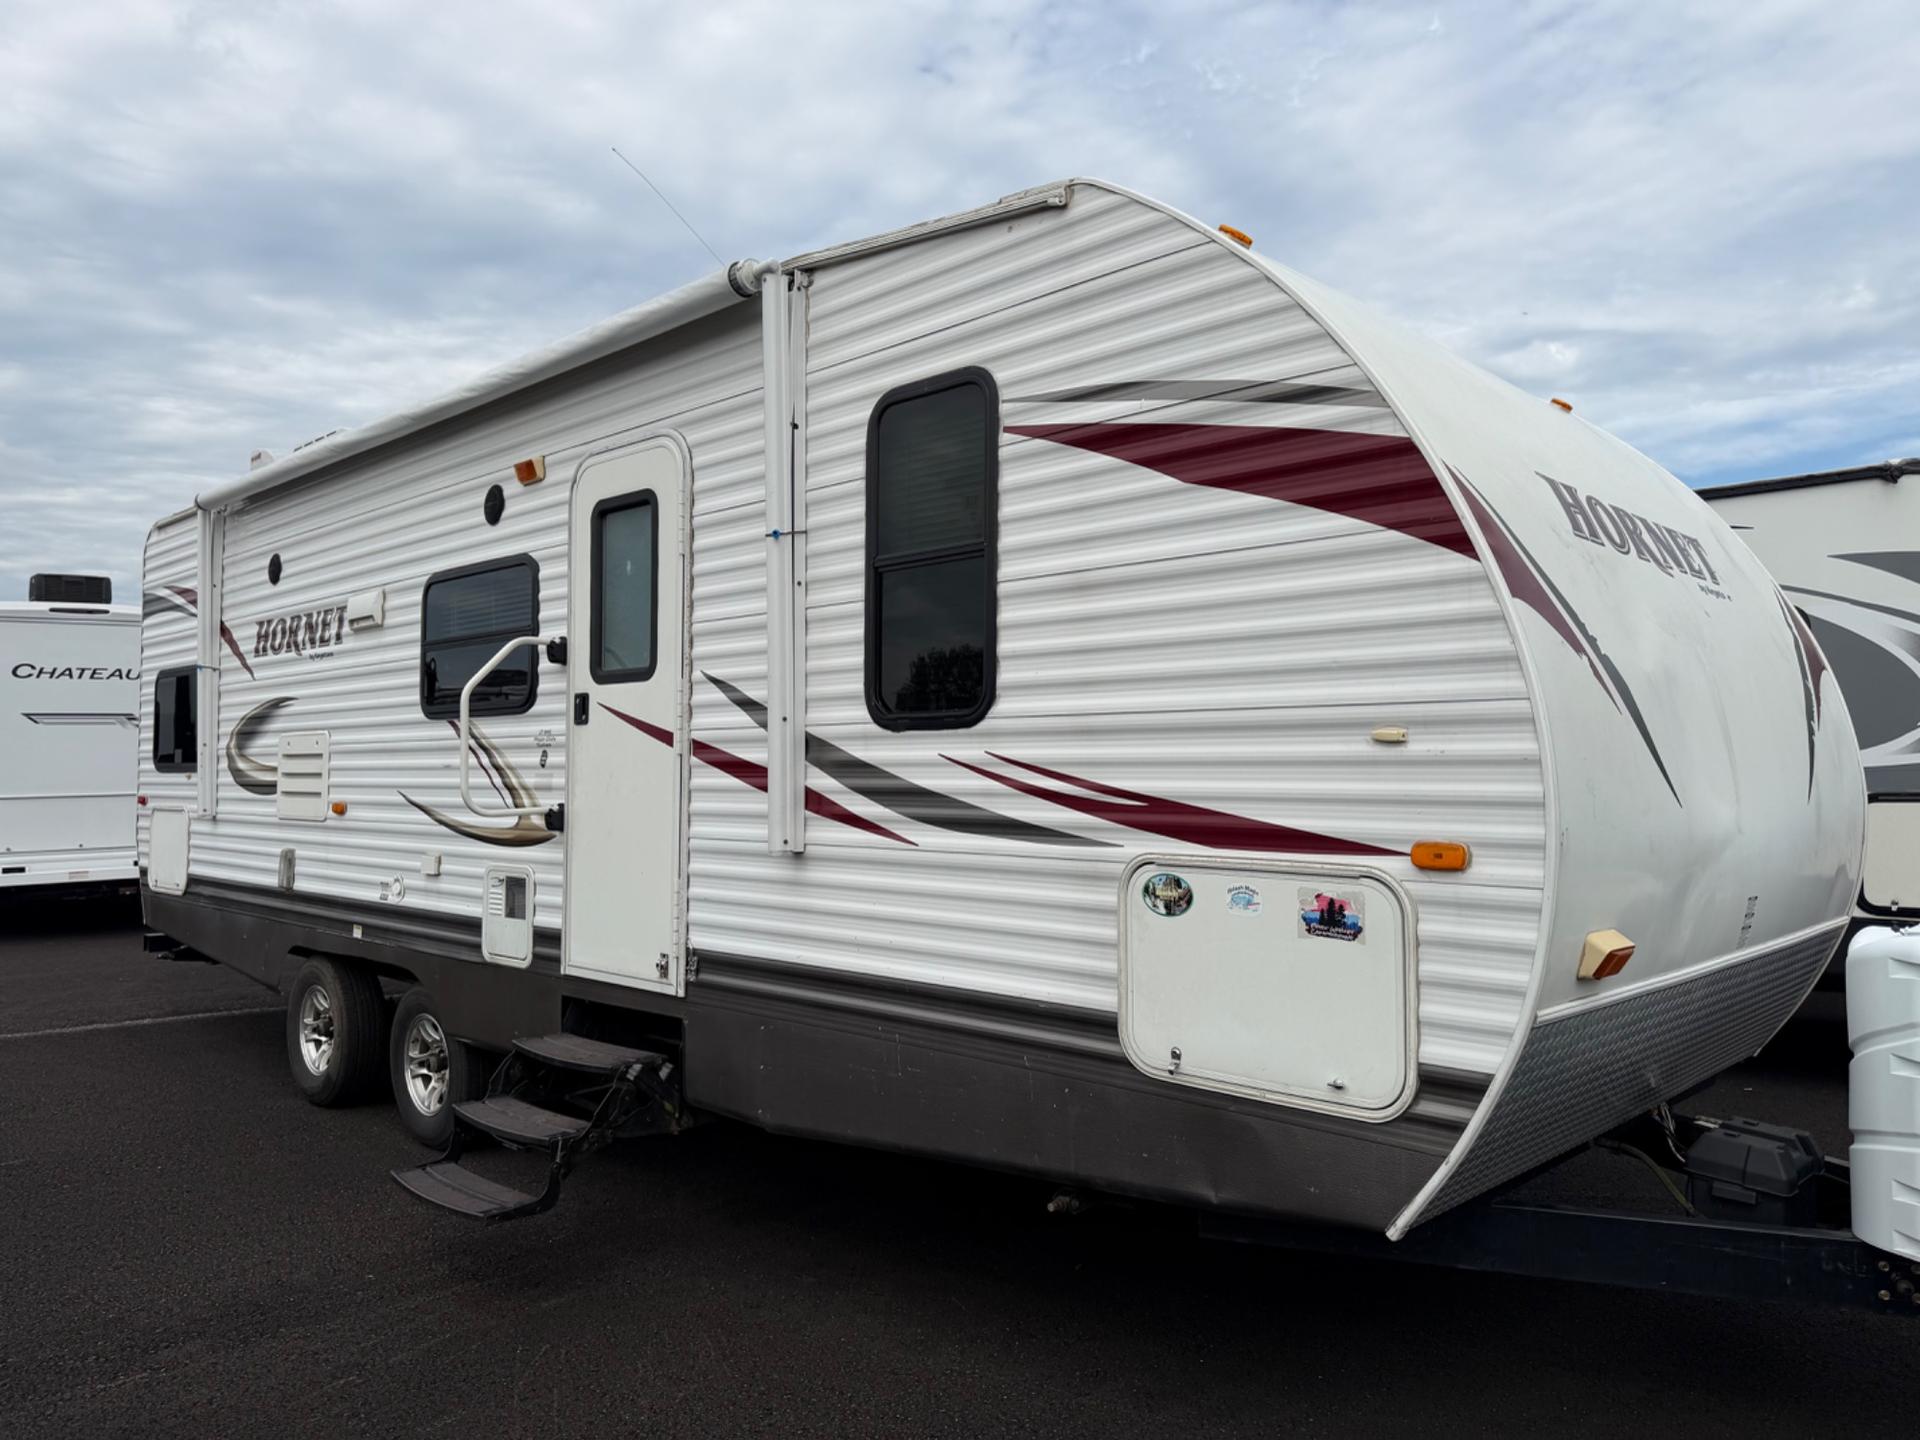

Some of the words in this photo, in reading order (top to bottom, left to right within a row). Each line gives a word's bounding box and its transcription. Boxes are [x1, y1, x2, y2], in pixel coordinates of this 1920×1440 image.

[1534, 470, 1720, 586] HORNET
[253, 606, 347, 656] HORNET
[11, 663, 140, 681] CHATEAU
